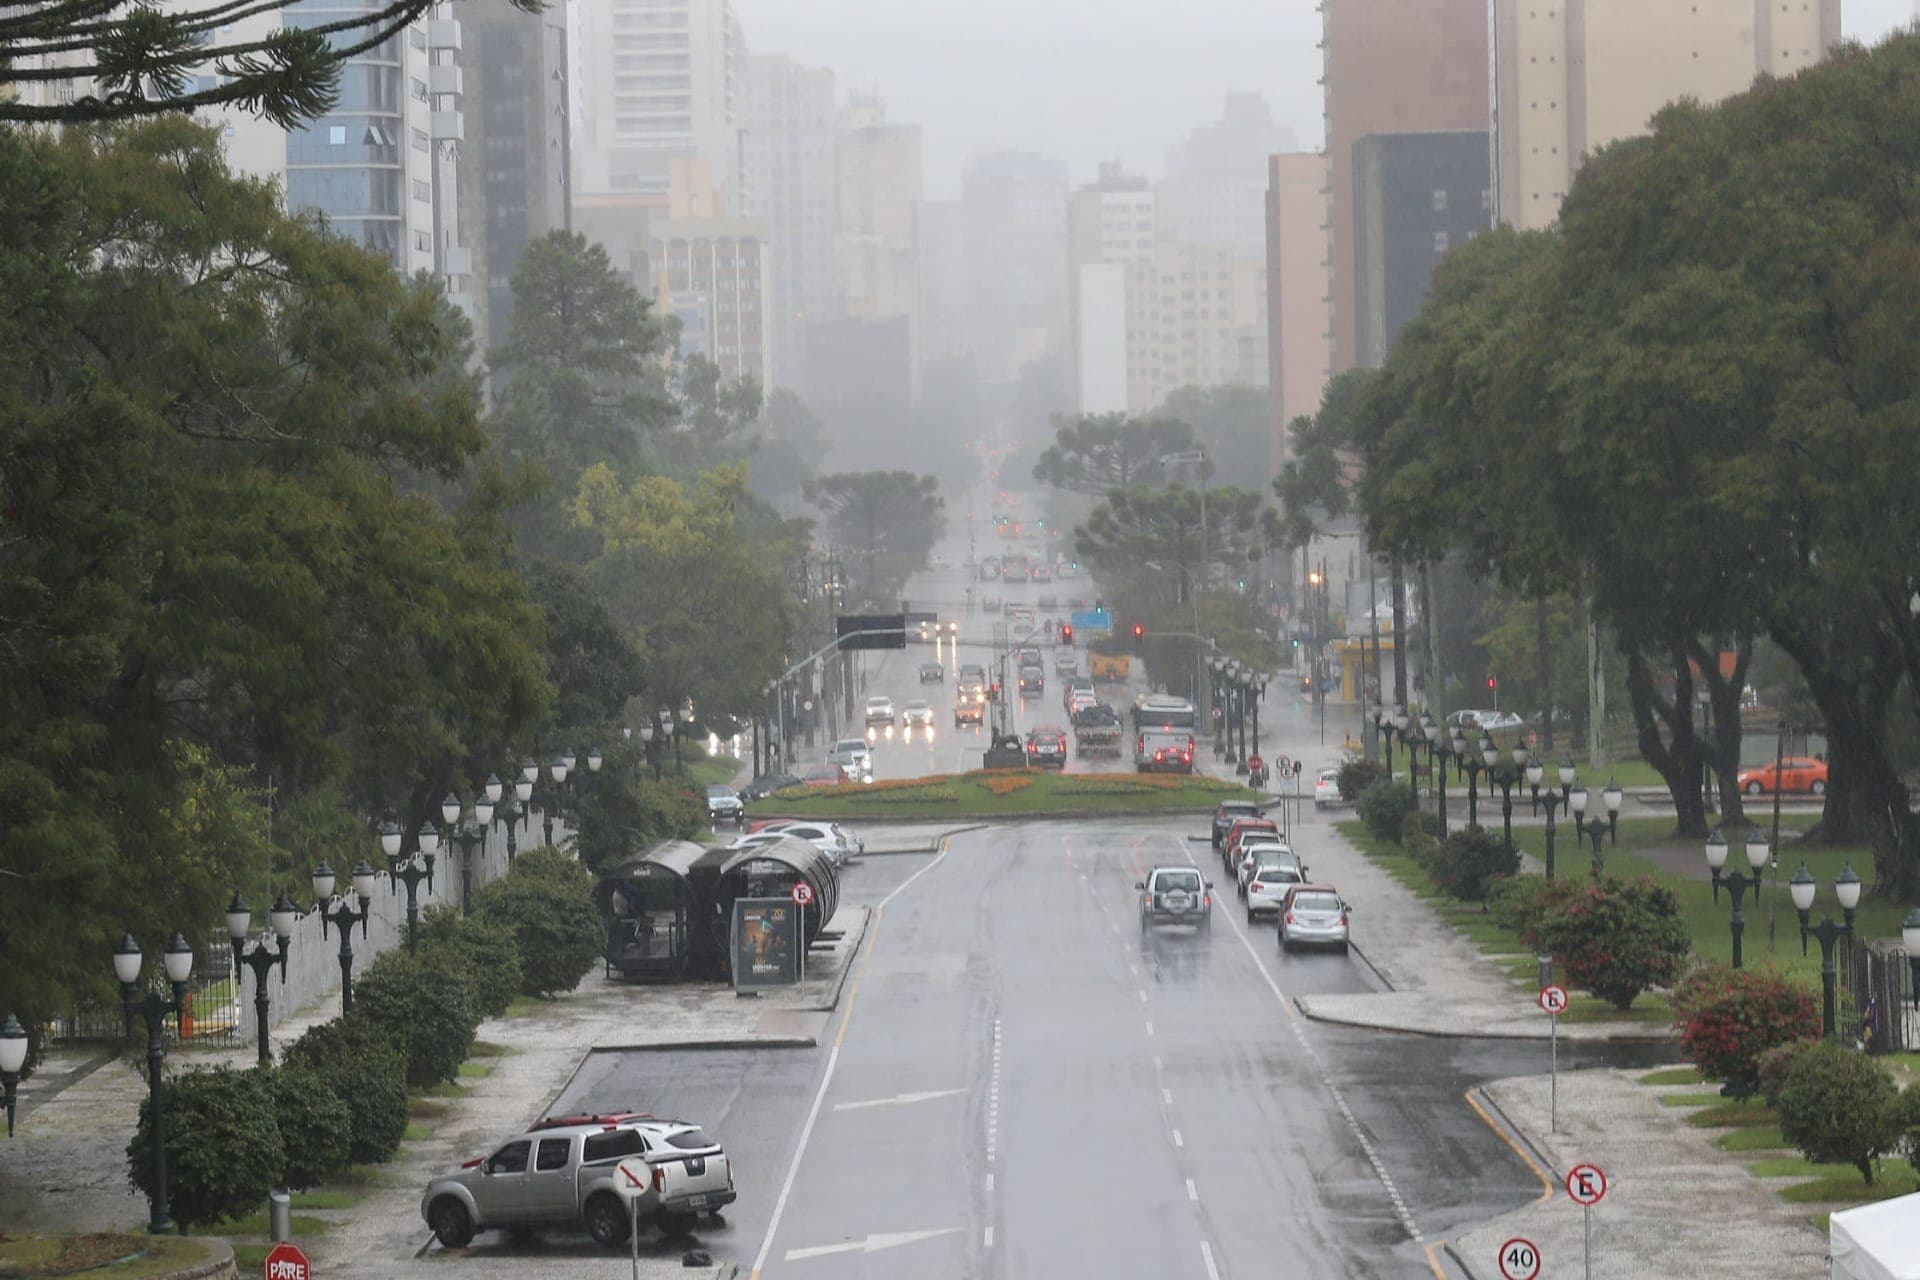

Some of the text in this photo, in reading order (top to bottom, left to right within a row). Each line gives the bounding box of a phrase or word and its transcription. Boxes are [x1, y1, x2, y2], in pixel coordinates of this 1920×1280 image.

[1548, 991, 1559, 1008] E
[1579, 1173, 1594, 1196] E
[1507, 1248, 1533, 1268] 40
[270, 1261, 305, 1280] PARE
